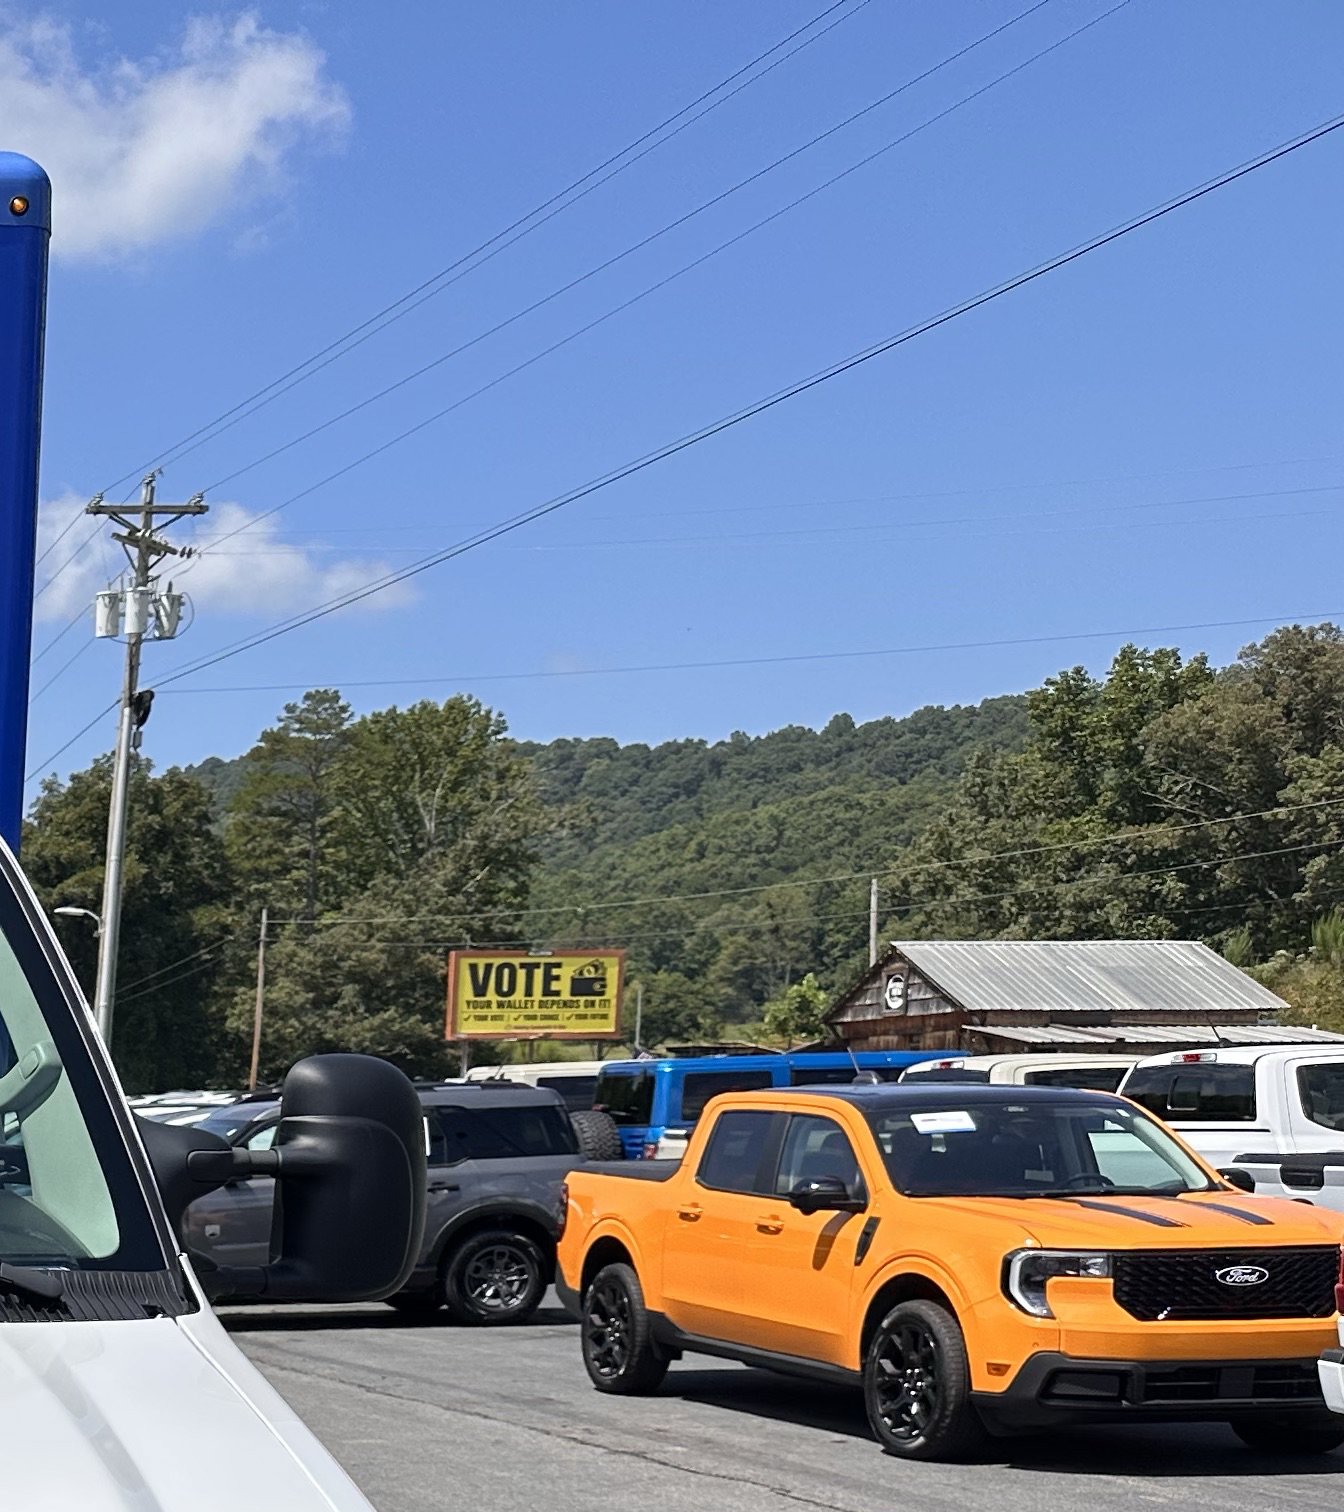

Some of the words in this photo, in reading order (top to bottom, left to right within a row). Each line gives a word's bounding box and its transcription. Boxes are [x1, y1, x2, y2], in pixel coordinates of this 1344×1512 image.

[468, 962, 563, 998] VOTE
[465, 1000, 492, 1009] YOUR
[496, 1000, 535, 1009] WALLET
[538, 1000, 581, 1009] DEPENDS
[583, 1000, 596, 1009] ON
[1225, 1268, 1260, 1283] Ford
